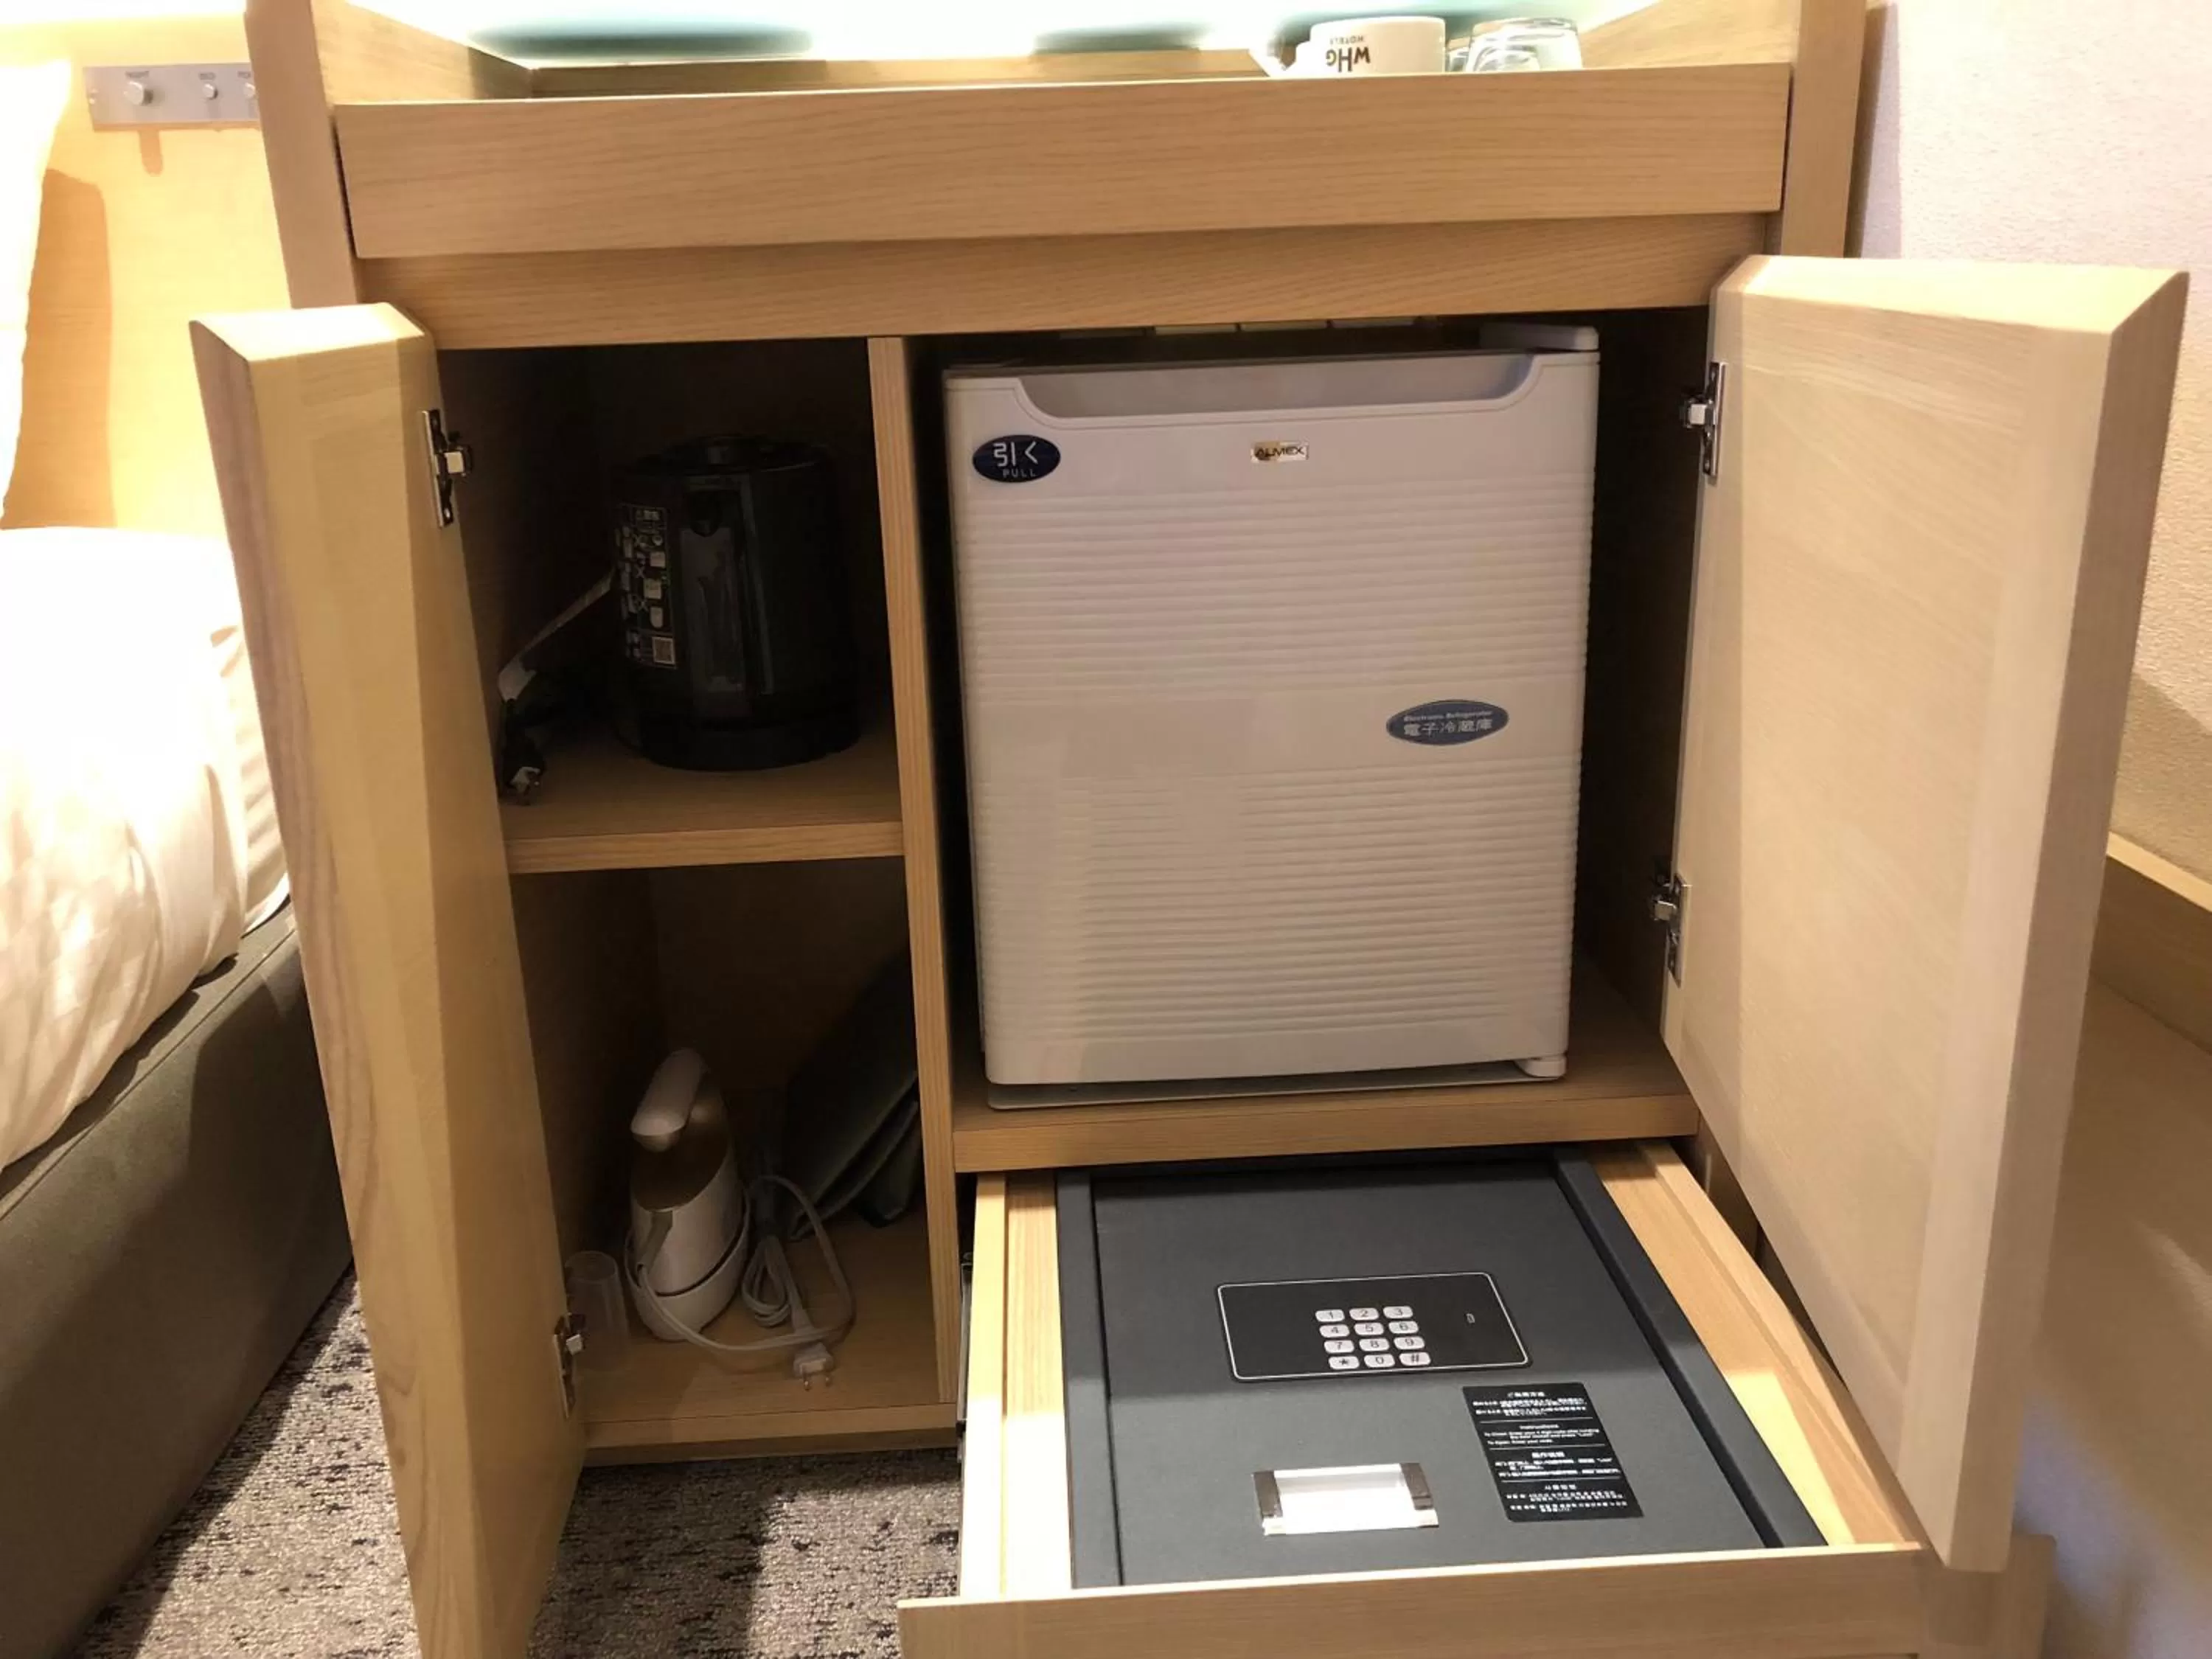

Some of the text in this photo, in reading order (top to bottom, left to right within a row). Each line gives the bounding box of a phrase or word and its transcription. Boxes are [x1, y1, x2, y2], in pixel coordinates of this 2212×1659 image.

[1326, 46, 1371, 73] WHG
[992, 441, 1039, 467] 引く
[1003, 468, 1037, 478] PULL
[1361, 1310, 1368, 1318] 2
[1366, 1324, 1374, 1333] 5
[1399, 1323, 1408, 1331] 6
[1371, 1340, 1379, 1349] 8
[1405, 1338, 1414, 1346] 9
